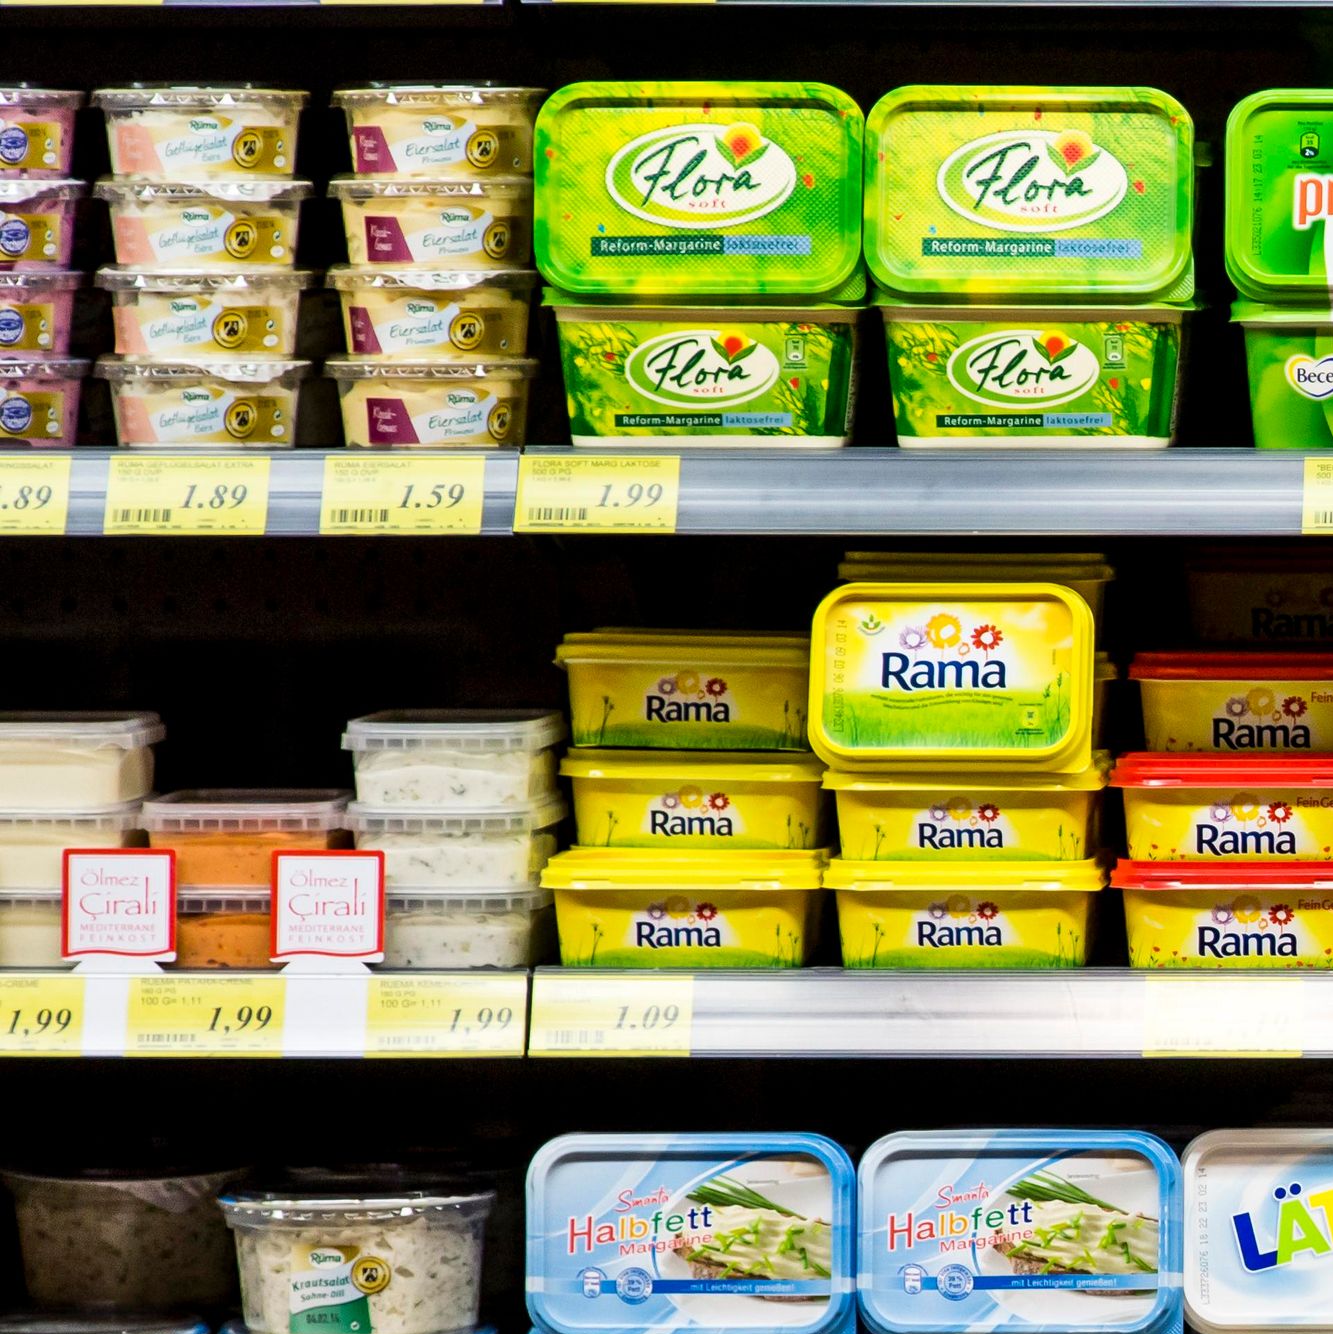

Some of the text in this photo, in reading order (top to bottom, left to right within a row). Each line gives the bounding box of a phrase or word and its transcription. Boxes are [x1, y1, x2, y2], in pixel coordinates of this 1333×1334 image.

[632, 142, 761, 211] Flora
[688, 199, 727, 209] soft
[622, 415, 721, 426] Reform-Margarine
[881, 651, 1007, 690] Rama
[81, 934, 155, 942] FEINKOST
[636, 921, 722, 949] Rama
[8, 1008, 71, 1034] 1,99
[208, 1006, 272, 1032] 1,99
[291, 1277, 349, 1291] Krautsalat
